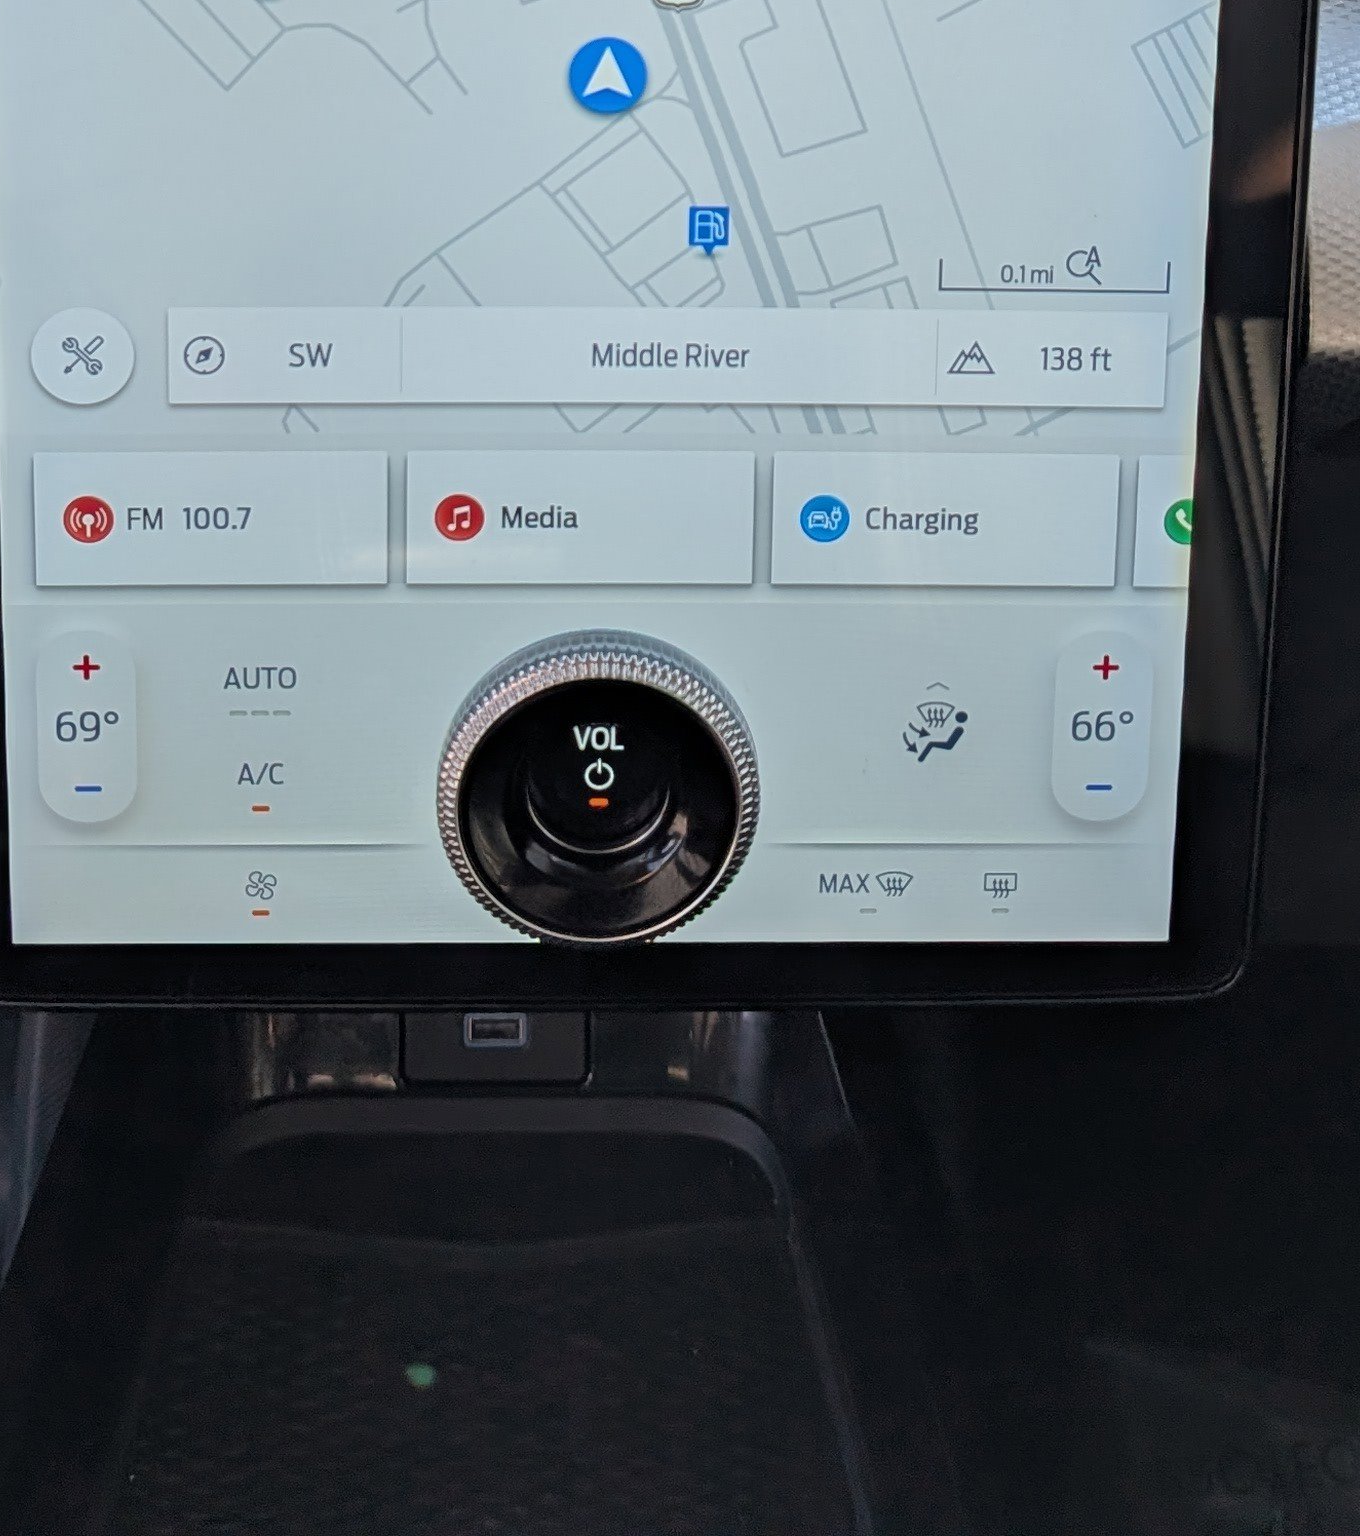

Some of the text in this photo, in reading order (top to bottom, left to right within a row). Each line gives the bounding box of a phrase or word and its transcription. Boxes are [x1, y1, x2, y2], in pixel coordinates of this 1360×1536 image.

[288, 342, 333, 368] SW
[592, 341, 750, 369] Middle River
[1040, 346, 1113, 372] 138 ft
[127, 506, 252, 531] FM 100.7
[501, 504, 579, 529] Media
[865, 506, 979, 536] Charging
[223, 666, 297, 690] AUTO
[572, 725, 625, 751] VOL
[237, 762, 284, 786] A/C
[818, 873, 870, 894] MAX
